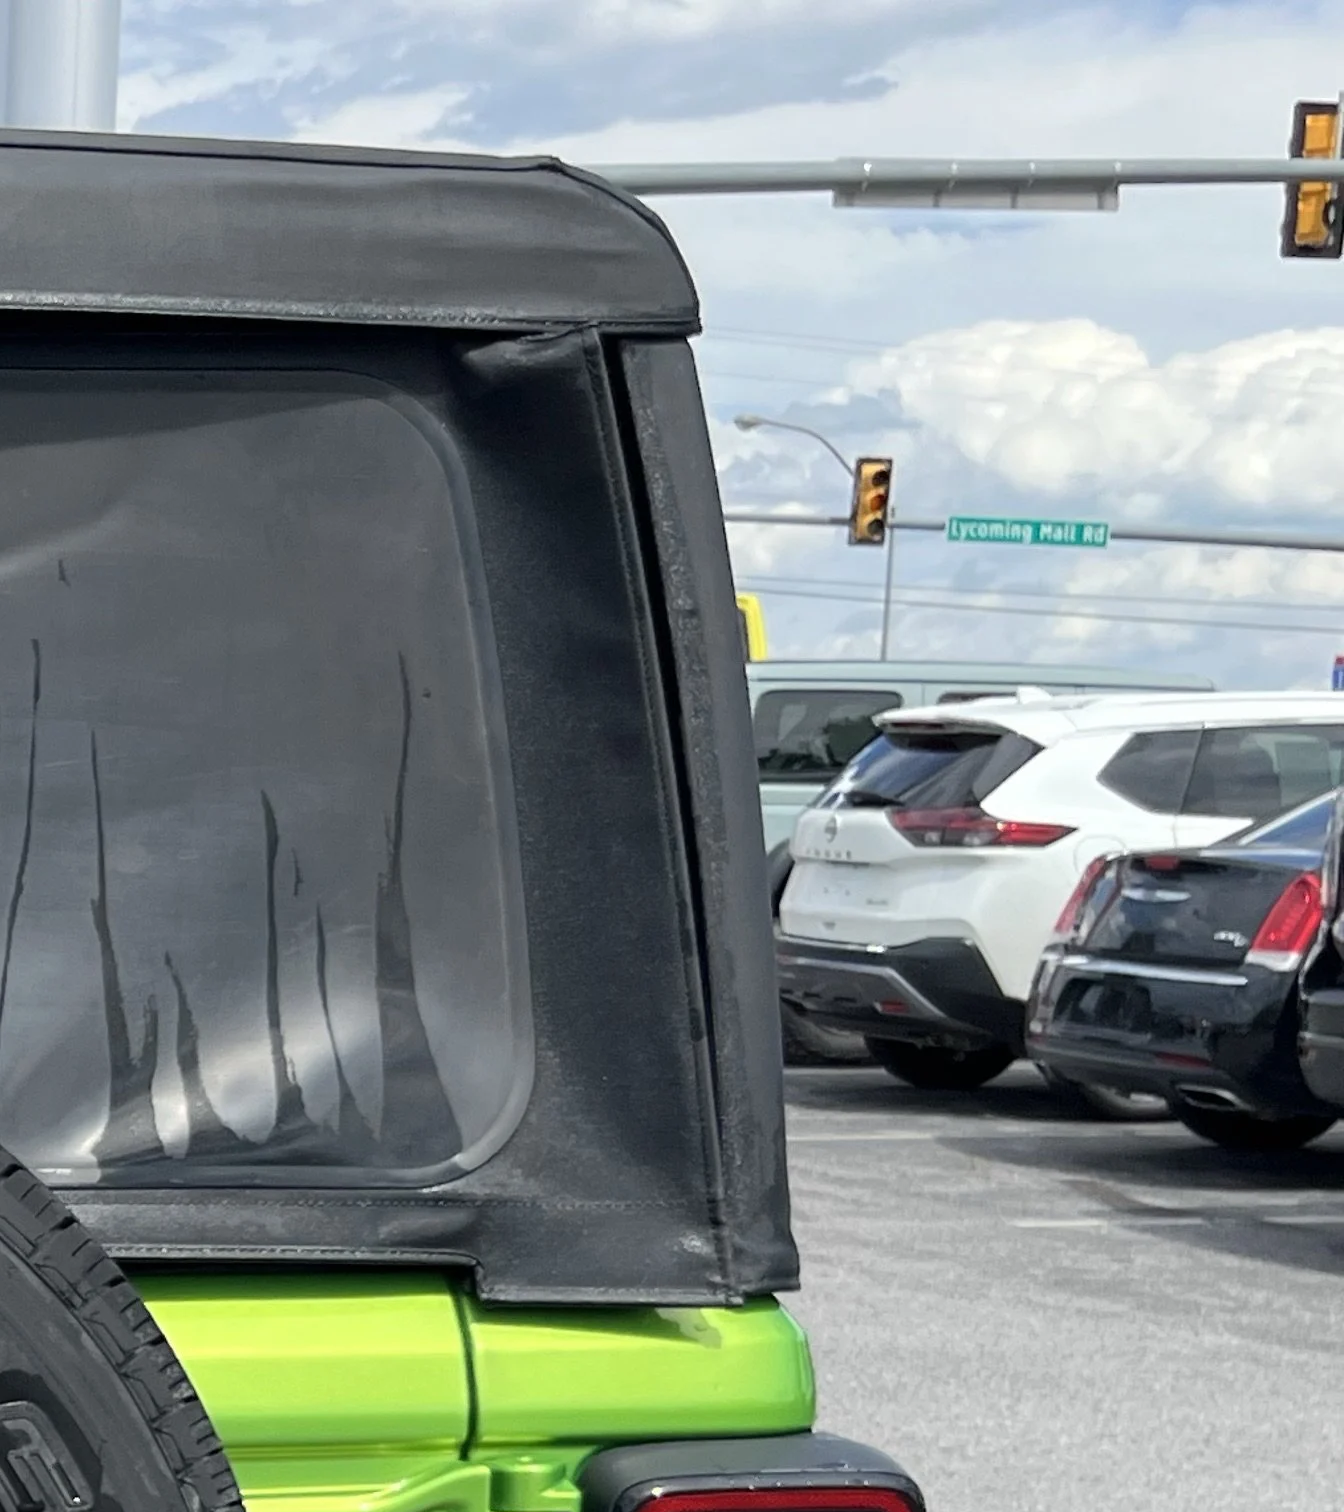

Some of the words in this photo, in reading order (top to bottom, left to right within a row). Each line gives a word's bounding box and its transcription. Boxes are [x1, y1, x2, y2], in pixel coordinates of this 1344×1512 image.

[951, 519, 1032, 544] Lycoming
[1039, 523, 1076, 543] Mall
[1082, 524, 1106, 544] Rd
